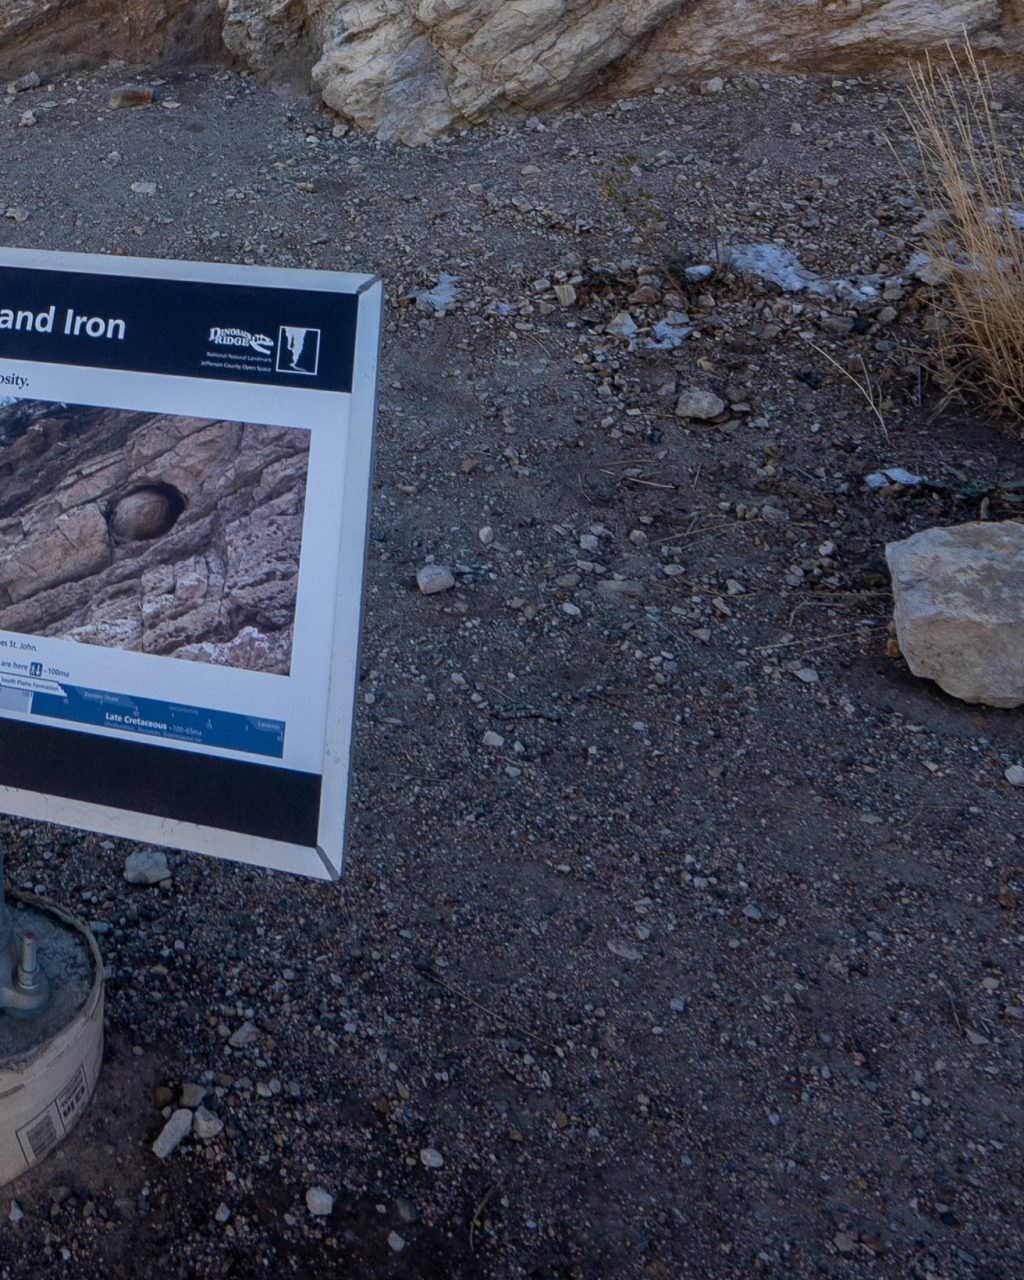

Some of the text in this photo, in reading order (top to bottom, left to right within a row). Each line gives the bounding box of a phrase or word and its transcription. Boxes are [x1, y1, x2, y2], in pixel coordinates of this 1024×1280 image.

[63, 308, 126, 340] Iron
[214, 335, 250, 346] RIDGE
[8, 639, 18, 649] St.
[19, 642, 38, 652] John.
[0, 660, 12, 669] are
[12, 660, 29, 672] here
[105, 711, 122, 722] Late
[123, 715, 167, 731] Cretaceous
